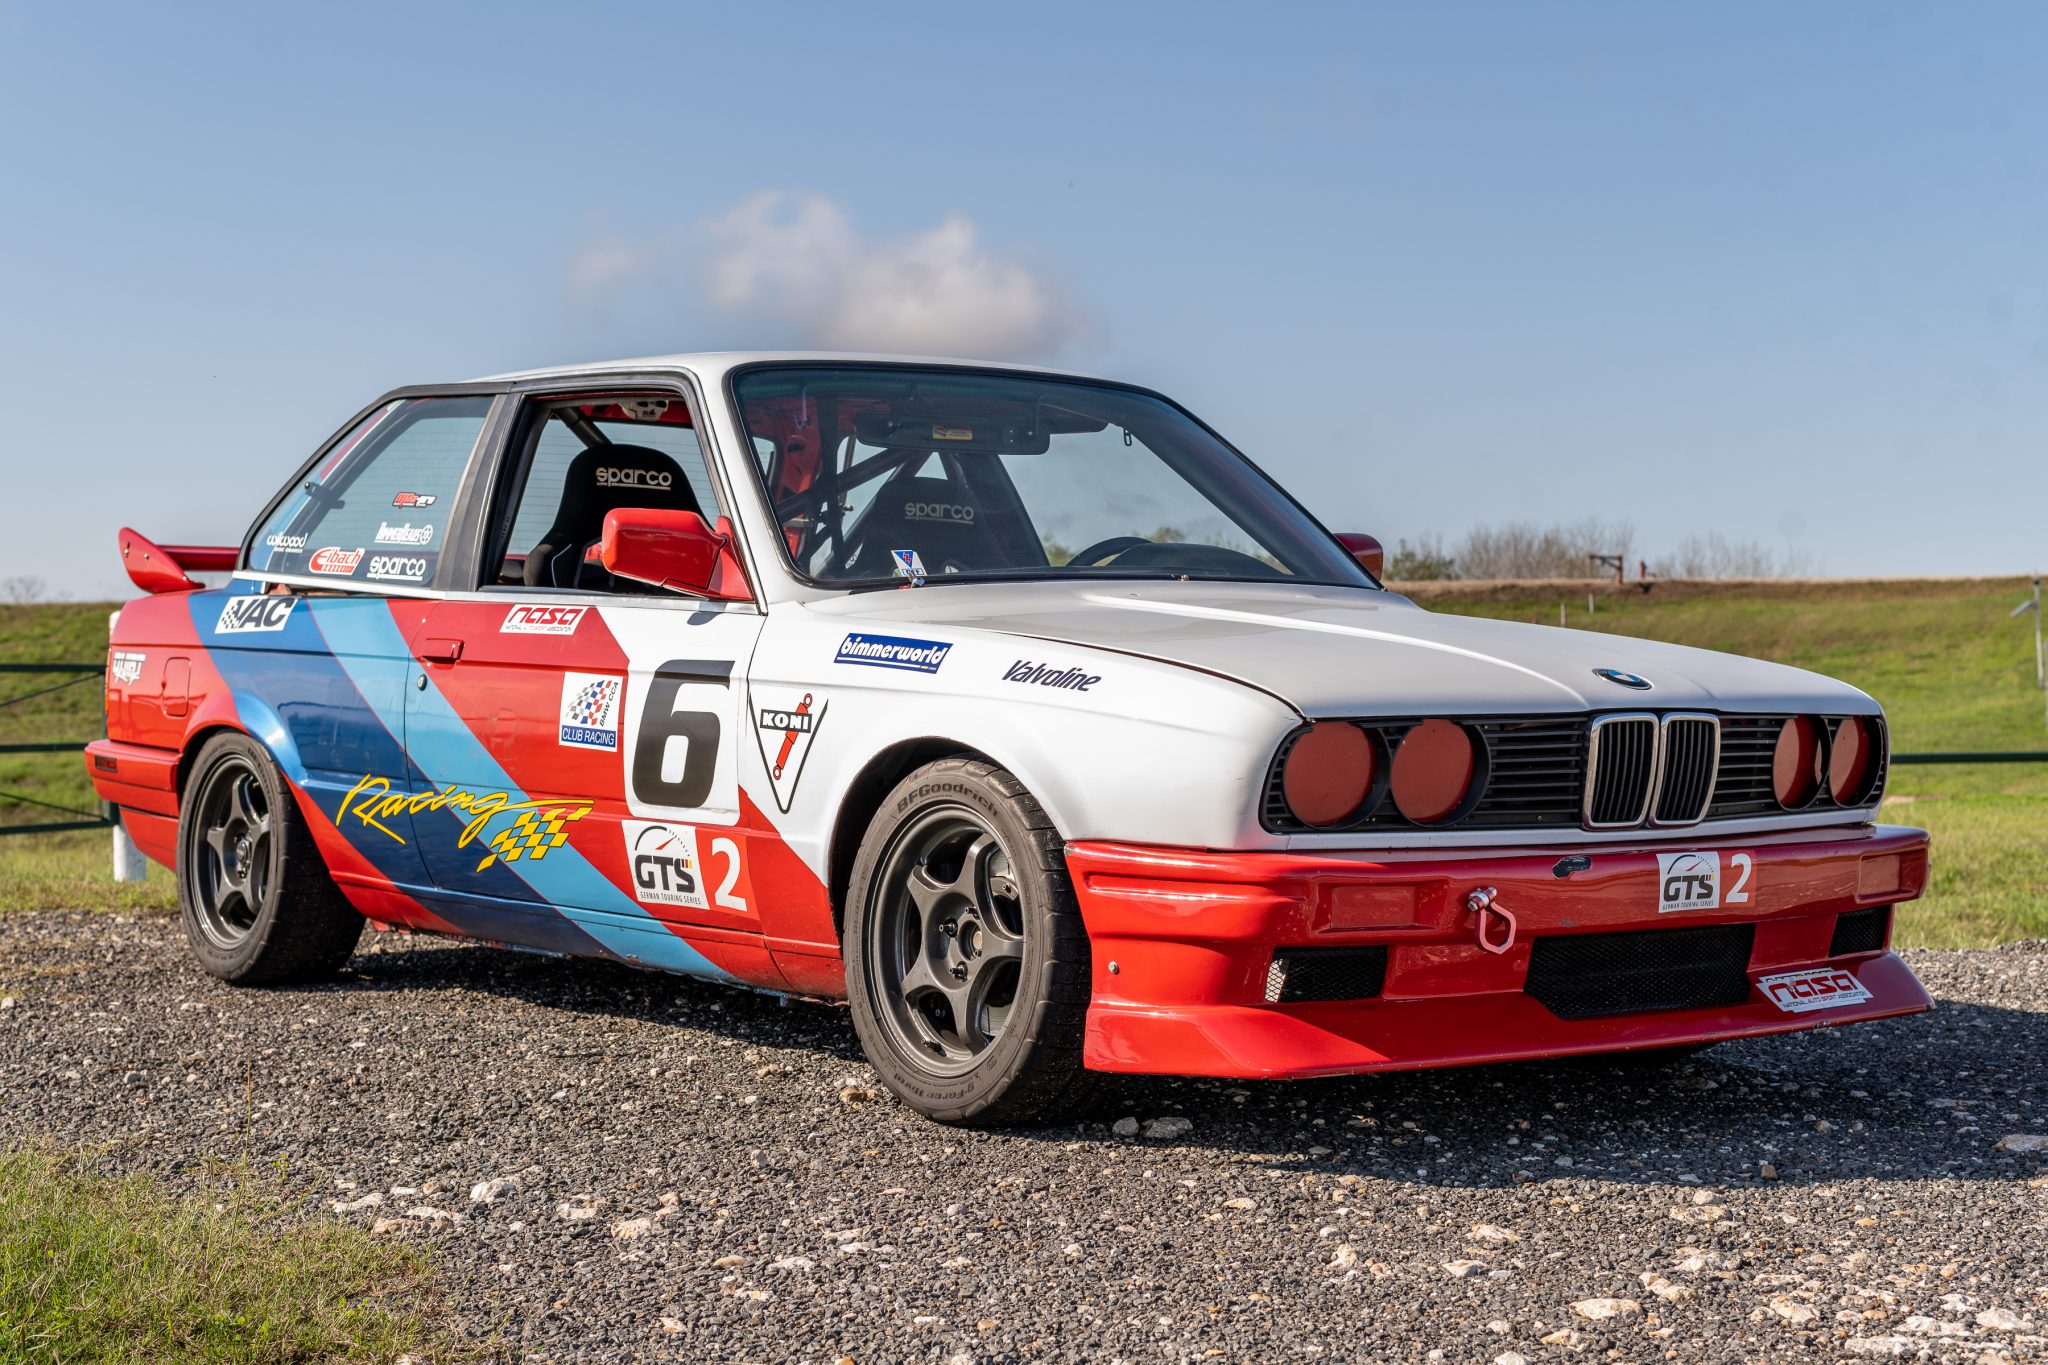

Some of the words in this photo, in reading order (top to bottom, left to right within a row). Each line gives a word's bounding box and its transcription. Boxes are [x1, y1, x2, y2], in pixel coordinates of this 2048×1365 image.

[596, 467, 672, 488] sparco
[904, 502, 974, 520] sparco
[311, 549, 361, 572] Eibach
[369, 556, 426, 578] sparco
[224, 597, 295, 629] VAC
[508, 607, 583, 625] nasa
[841, 636, 948, 665] bimmerworld
[1002, 659, 1102, 692] Valvoline
[599, 702, 610, 727] BMW
[608, 682, 619, 701] CCA
[632, 659, 736, 808] 6
[763, 711, 809, 731] KONI
[562, 727, 583, 741] CLUB
[584, 730, 615, 745] RACING
[335, 773, 594, 849] Racing
[897, 783, 998, 817] BFGoodrich
[634, 854, 696, 894] GTS
[711, 837, 747, 912] 2
[1663, 874, 1714, 902] GTS
[1725, 853, 1752, 903] 2
[640, 891, 661, 900] GERMAN
[661, 893, 683, 903] TOURING
[683, 896, 702, 905] SERIES
[1662, 903, 1680, 911] GERMAN
[1680, 901, 1699, 909] TOURING
[1768, 973, 1859, 1003] nasa
[1782, 1000, 1807, 1009] NATIONAL
